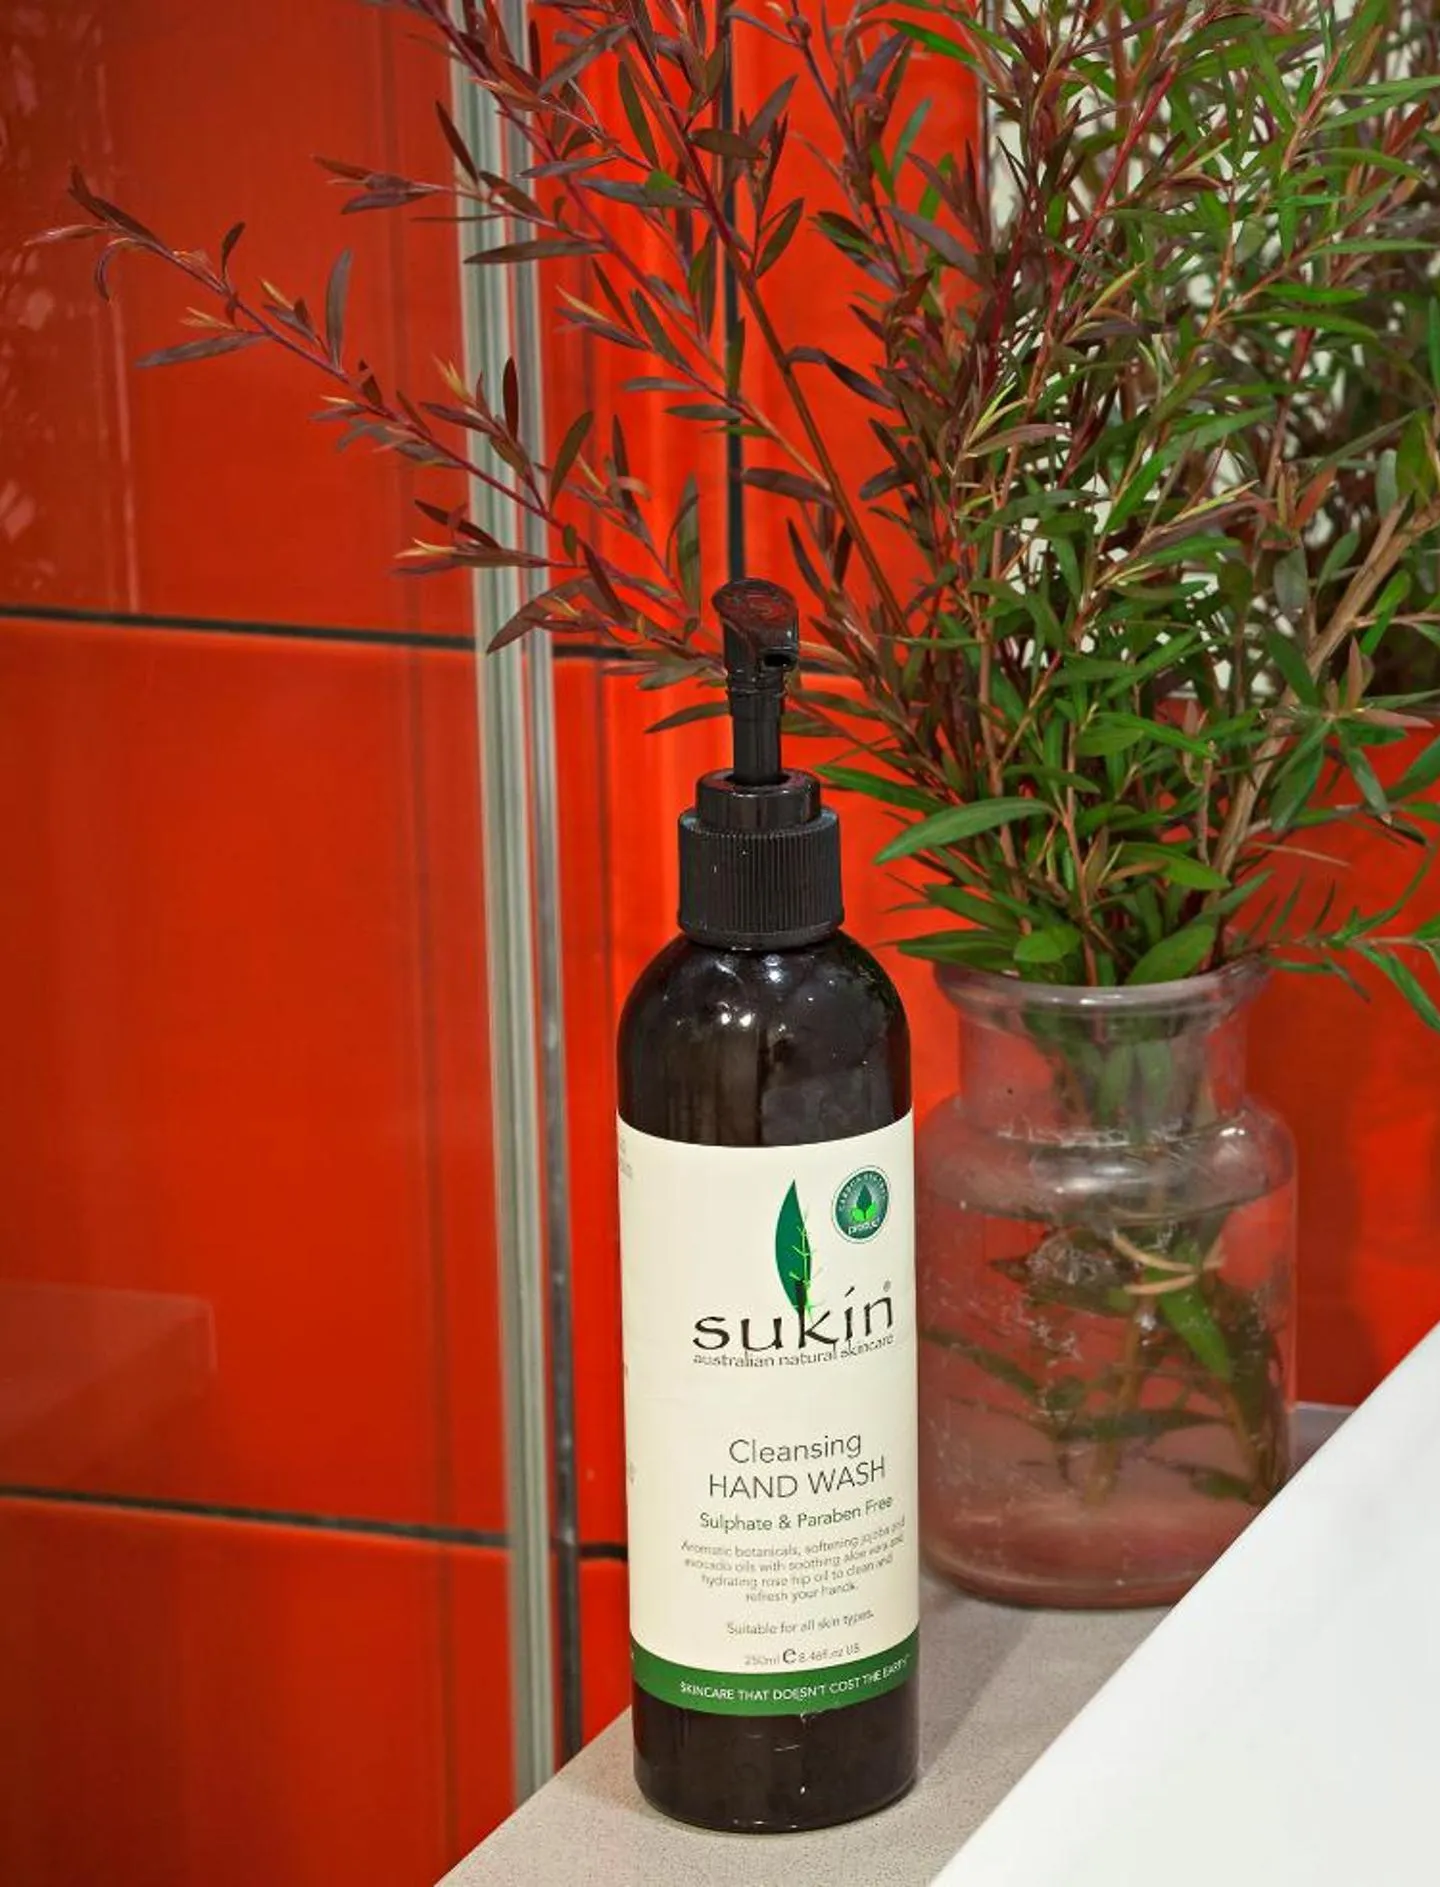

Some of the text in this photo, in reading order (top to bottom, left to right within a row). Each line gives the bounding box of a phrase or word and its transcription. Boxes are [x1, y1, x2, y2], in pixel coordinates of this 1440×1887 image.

[693, 1334, 895, 1368] australian natural skincare
[729, 1434, 862, 1464] Cleansing
[709, 1455, 886, 1500] HAND WASH
[699, 1496, 894, 1535] Sulphate & Paraben Free
[804, 1536, 860, 1556] softening
[759, 1559, 787, 1573] with
[788, 1555, 841, 1571] soothing
[761, 1576, 789, 1588] rose
[831, 1568, 844, 1582] to
[744, 1589, 789, 1603] refresh
[791, 1587, 819, 1605] your
[726, 1621, 779, 1636] Suitable
[780, 1621, 798, 1635] for
[800, 1618, 816, 1633] all
[817, 1615, 841, 1631] skin
[679, 1679, 736, 1701] SKINCARE
[737, 1688, 770, 1702] THAT
[772, 1684, 826, 1702] DOESN'T
[828, 1677, 860, 1695] COST
[861, 1669, 882, 1686] THE
